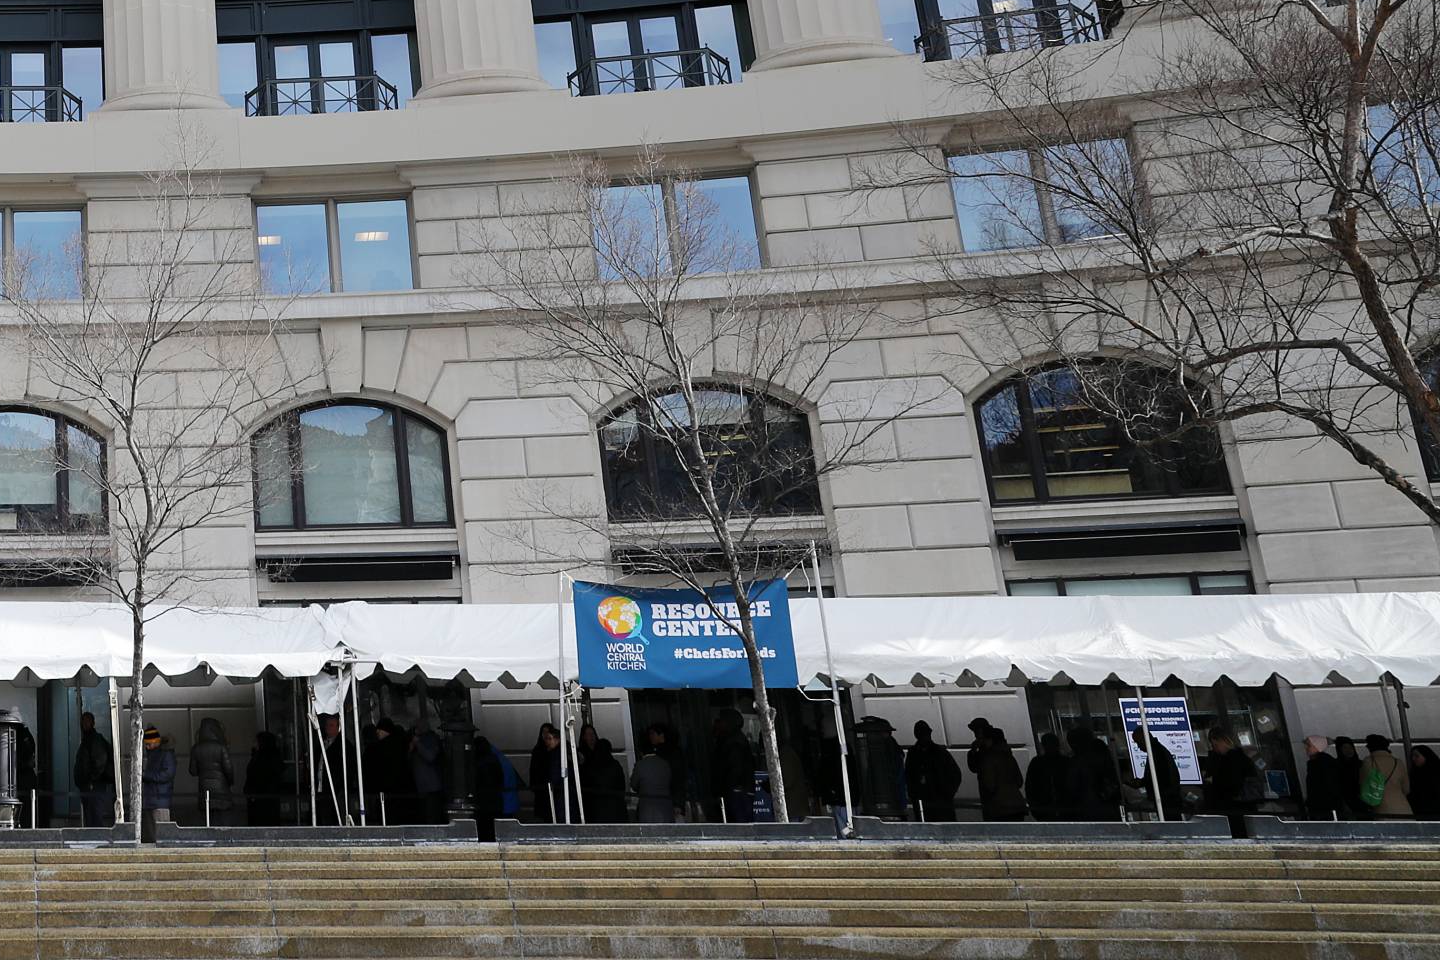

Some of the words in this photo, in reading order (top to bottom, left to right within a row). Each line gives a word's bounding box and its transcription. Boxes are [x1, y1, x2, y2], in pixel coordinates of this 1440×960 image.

[606, 643, 645, 653] WORLD
[674, 647, 777, 659] #ChefsFords
[606, 652, 646, 662] CENTRAL
[607, 661, 647, 671] KITCHEN
